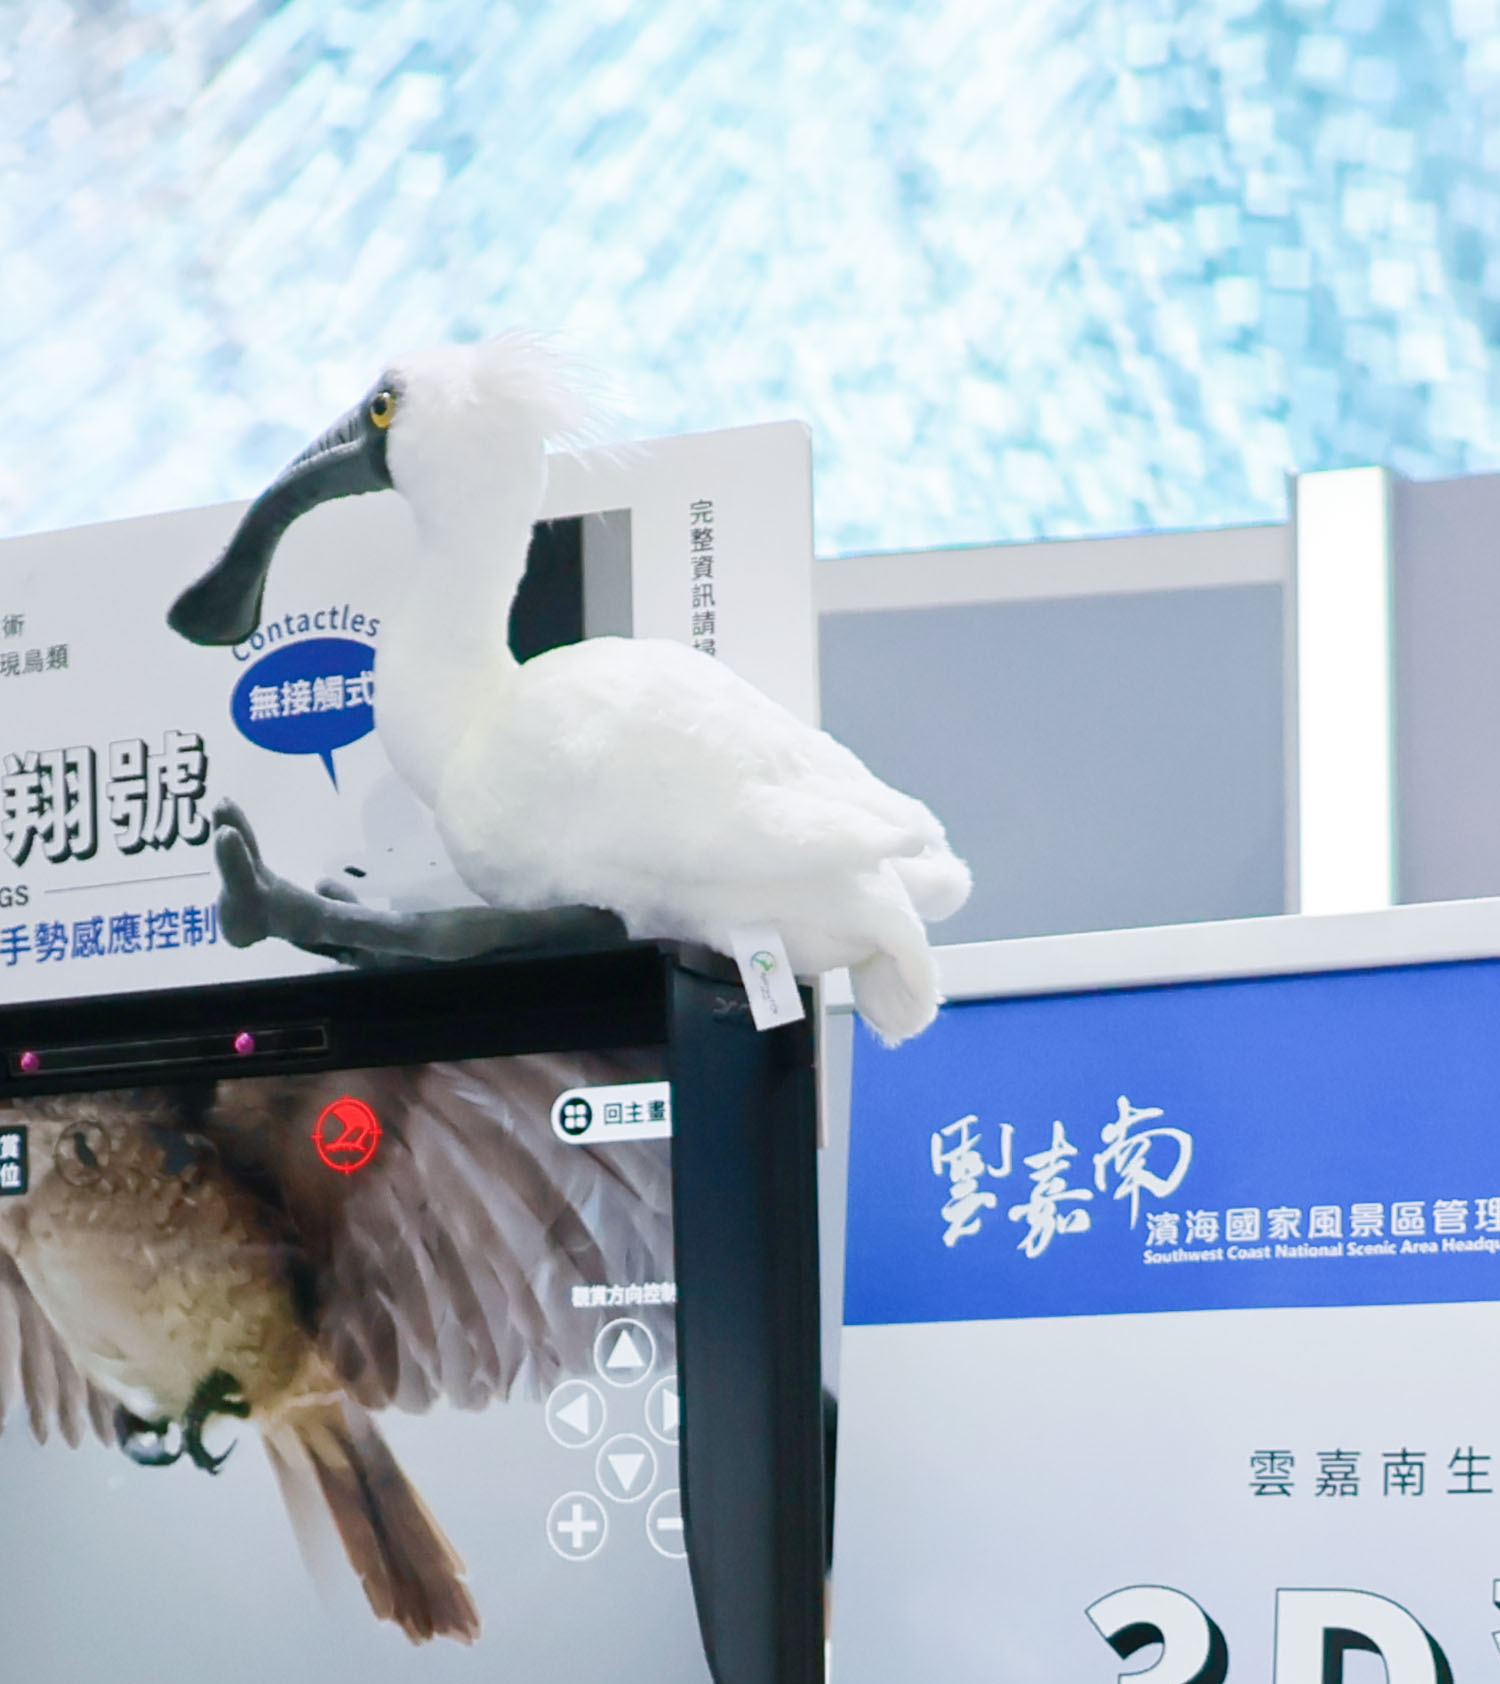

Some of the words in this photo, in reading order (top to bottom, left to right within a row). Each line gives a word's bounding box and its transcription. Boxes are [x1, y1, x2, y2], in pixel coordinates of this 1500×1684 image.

[249, 670, 376, 722] 無接觸式
[1143, 1246, 1224, 1264] Southwest
[1227, 1244, 1270, 1260] Coast
[1274, 1242, 1343, 1258] National
[1346, 1240, 1396, 1256] Scenic
[1400, 1239, 1439, 1254] Area
